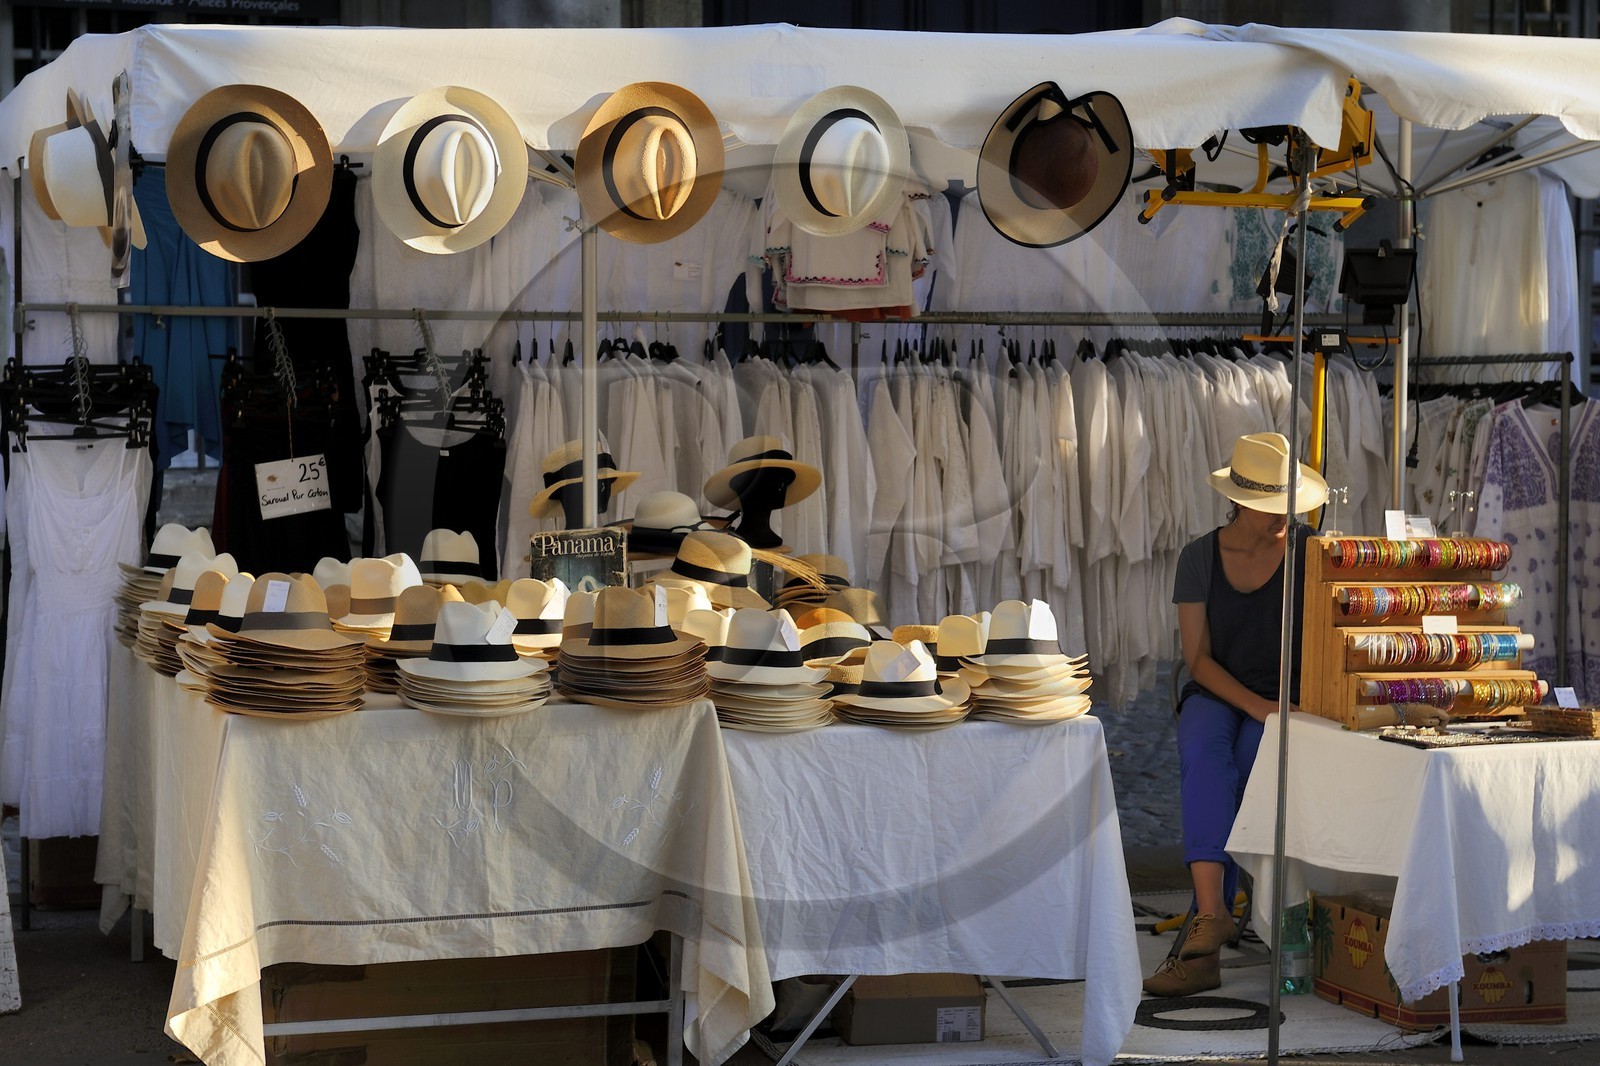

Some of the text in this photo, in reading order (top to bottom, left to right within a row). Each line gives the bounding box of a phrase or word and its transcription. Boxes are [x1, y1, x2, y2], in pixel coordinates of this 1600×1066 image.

[232, 0, 299, 14] Provençales
[292, 489, 304, 501] Pur
[307, 487, 328, 499] Coton
[532, 533, 616, 557] Panama
[1344, 935, 1372, 953] KOUMBA
[1473, 982, 1511, 991] KOUMBA
